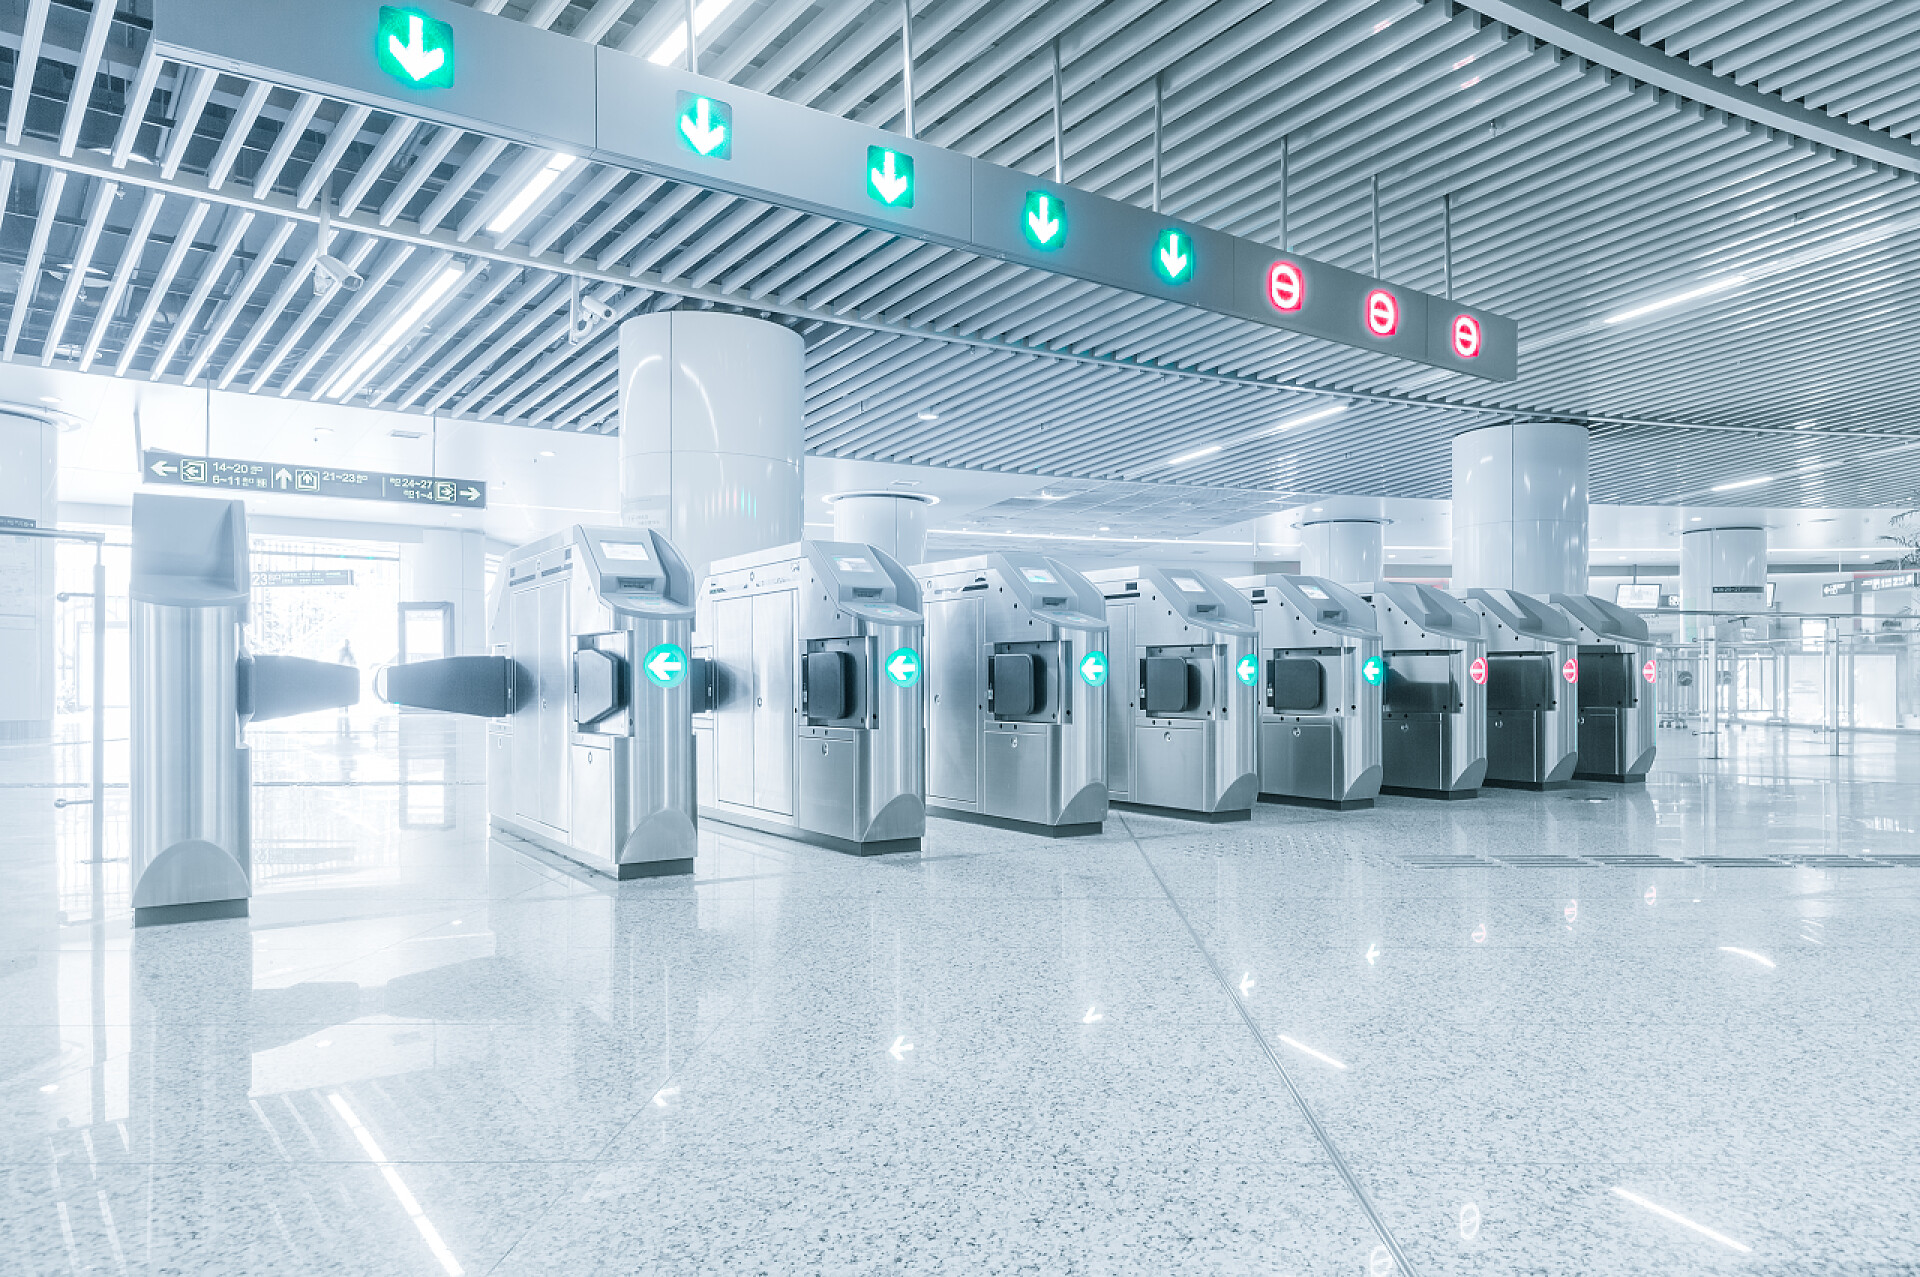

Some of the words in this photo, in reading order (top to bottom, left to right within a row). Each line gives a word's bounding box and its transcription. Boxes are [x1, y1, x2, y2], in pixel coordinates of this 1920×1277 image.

[213, 462, 248, 474] 14~20
[322, 471, 355, 483] 21~23
[252, 573, 268, 586] 23
